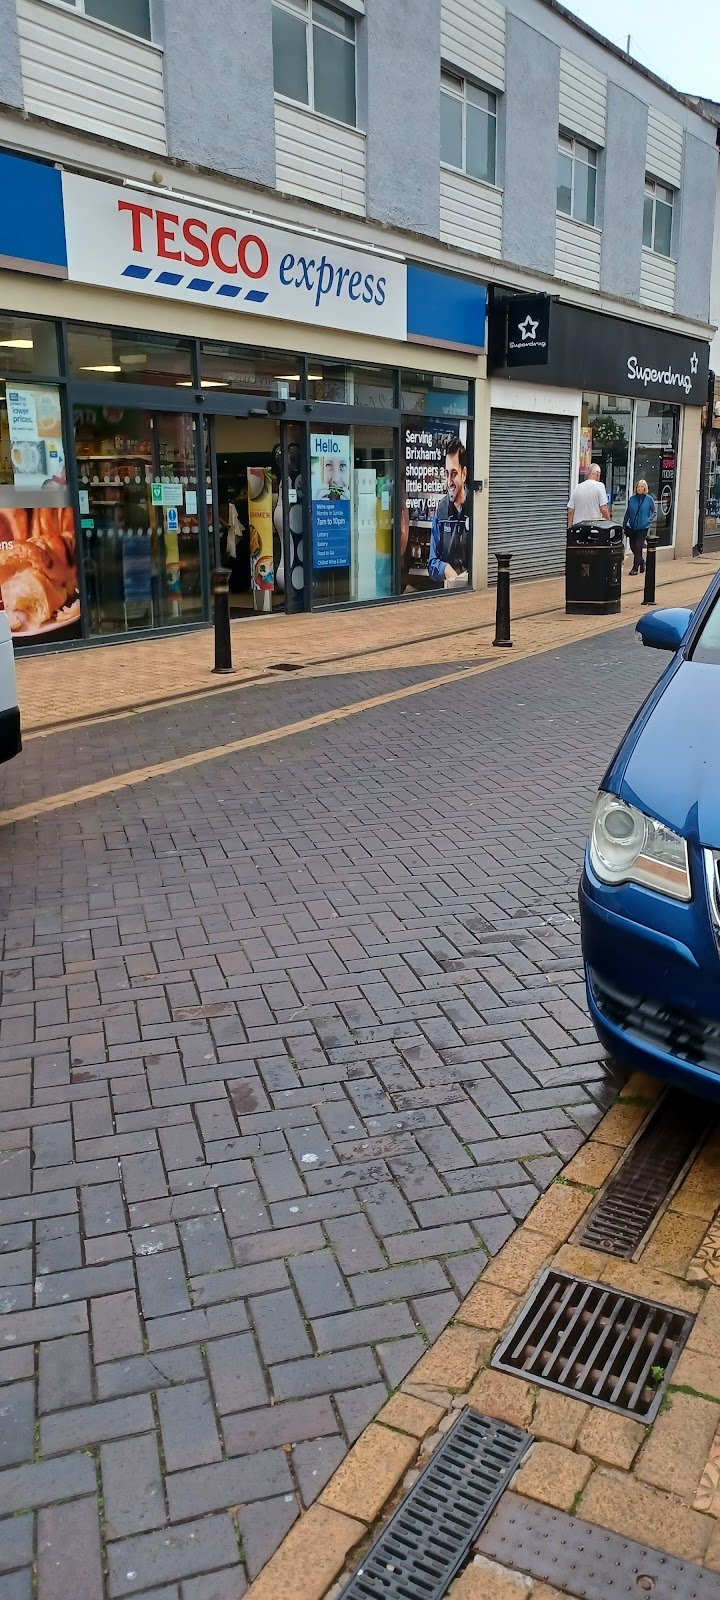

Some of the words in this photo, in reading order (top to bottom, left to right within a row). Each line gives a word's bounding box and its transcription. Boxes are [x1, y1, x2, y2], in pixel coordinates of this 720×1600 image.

[117, 199, 269, 280] TESCO
[278, 253, 387, 307] express
[509, 340, 547, 349] Superdrug
[627, 356, 692, 394] Superdrug
[315, 438, 341, 453] Hello.
[405, 430, 432, 447] Serving
[405, 447, 441, 460] Brixham's
[405, 464, 438, 479] shoppers
[439, 467, 445, 477] a
[405, 480, 422, 493] little
[423, 480, 445, 493] better
[405, 497, 427, 511] every
[426, 495, 440, 510] day
[317, 518, 327, 526] 7am
[327, 518, 333, 526] to
[333, 517, 346, 527] 10pm
